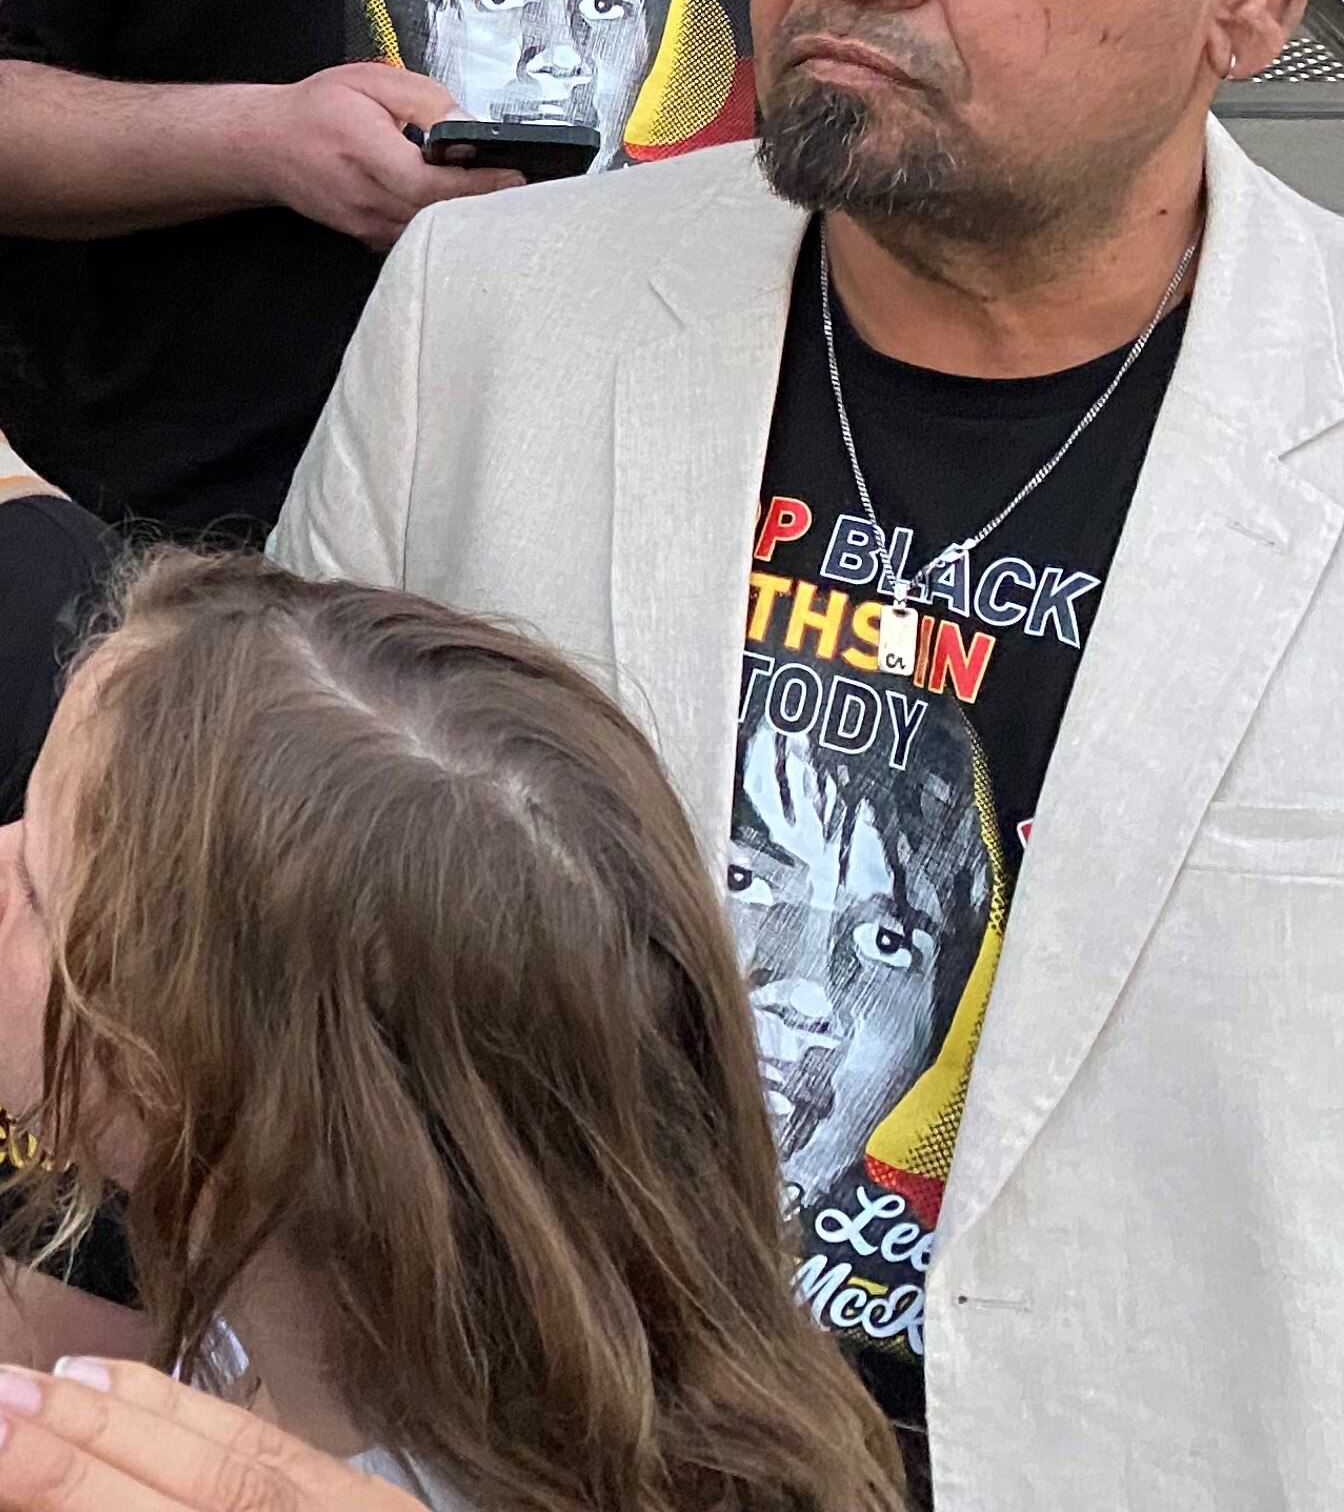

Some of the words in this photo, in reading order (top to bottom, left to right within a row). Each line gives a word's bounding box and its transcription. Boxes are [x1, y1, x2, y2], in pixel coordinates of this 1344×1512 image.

[746, 571, 884, 674] THS
[914, 615, 996, 704] IN
[819, 514, 1102, 650] BLACK
[738, 650, 928, 771] TODY
